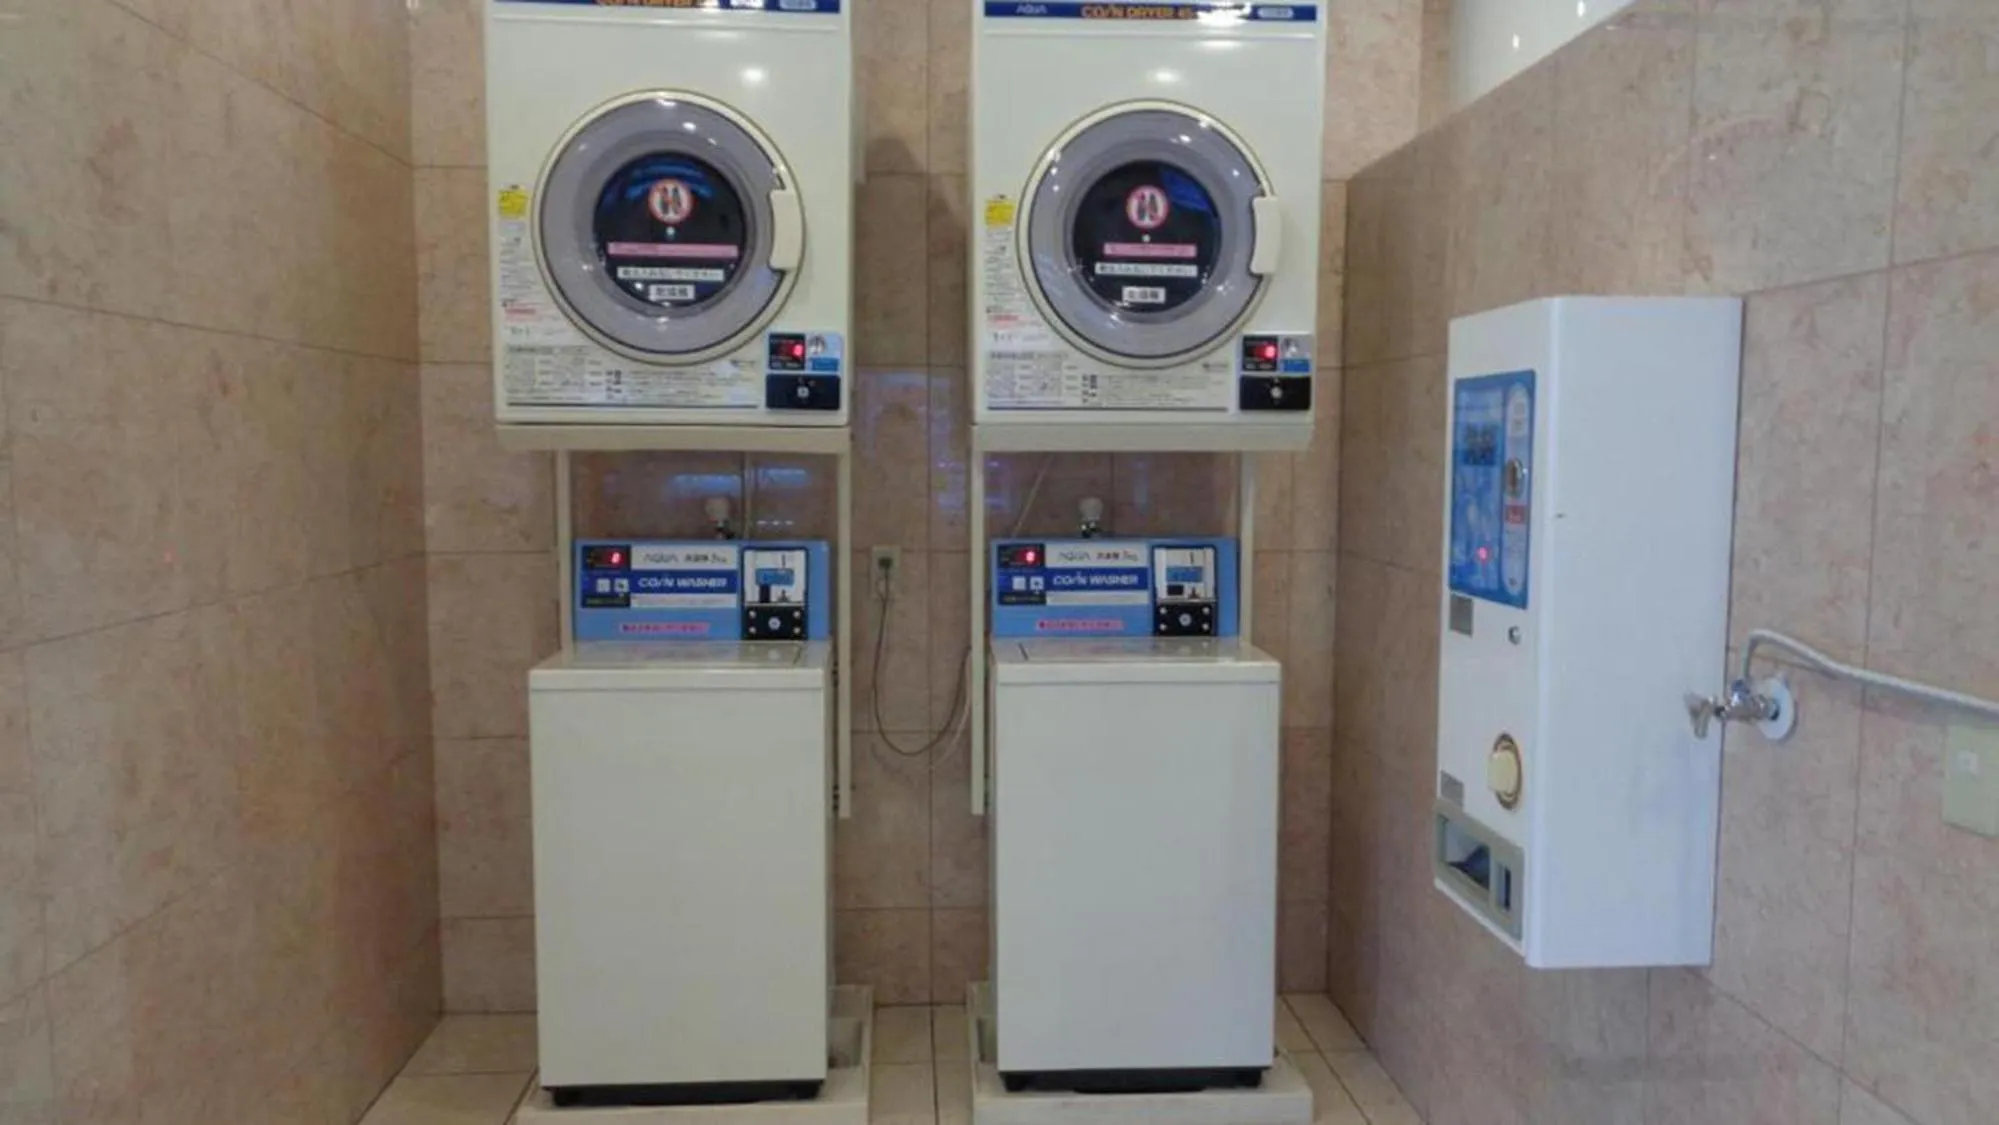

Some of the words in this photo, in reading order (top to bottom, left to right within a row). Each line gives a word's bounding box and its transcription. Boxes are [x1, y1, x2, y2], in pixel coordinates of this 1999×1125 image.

[1016, 4, 1048, 15] AQUA
[643, 552, 679, 563] AQUA
[676, 577, 728, 588] WASHER
[1089, 574, 1139, 586] WASHER
